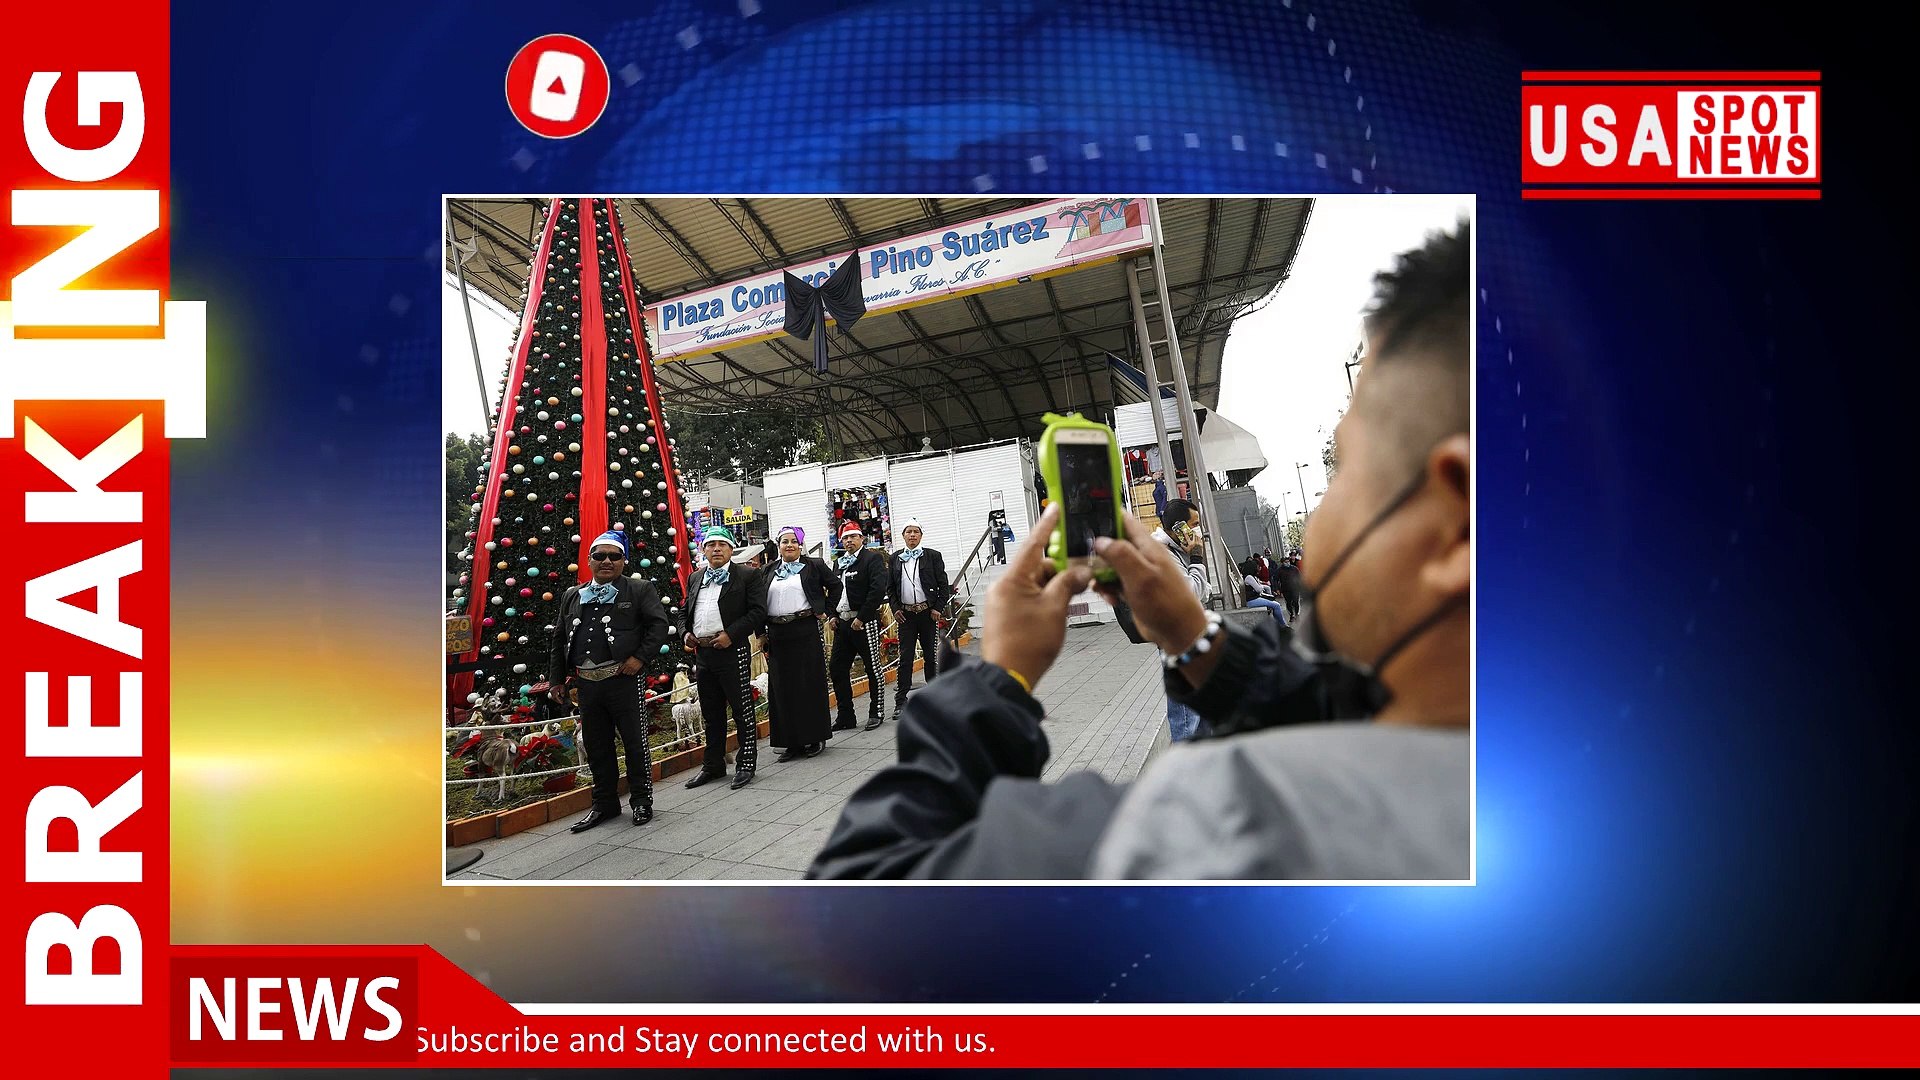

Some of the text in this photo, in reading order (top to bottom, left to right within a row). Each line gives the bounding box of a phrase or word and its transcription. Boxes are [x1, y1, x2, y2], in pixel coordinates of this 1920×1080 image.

[662, 297, 725, 332] Plaza
[870, 245, 934, 280] Pino
[941, 217, 1050, 262] Suárez
[754, 310, 786, 330] Socia
[905, 273, 947, 295] Flores
[725, 514, 752, 524] SALIDA
